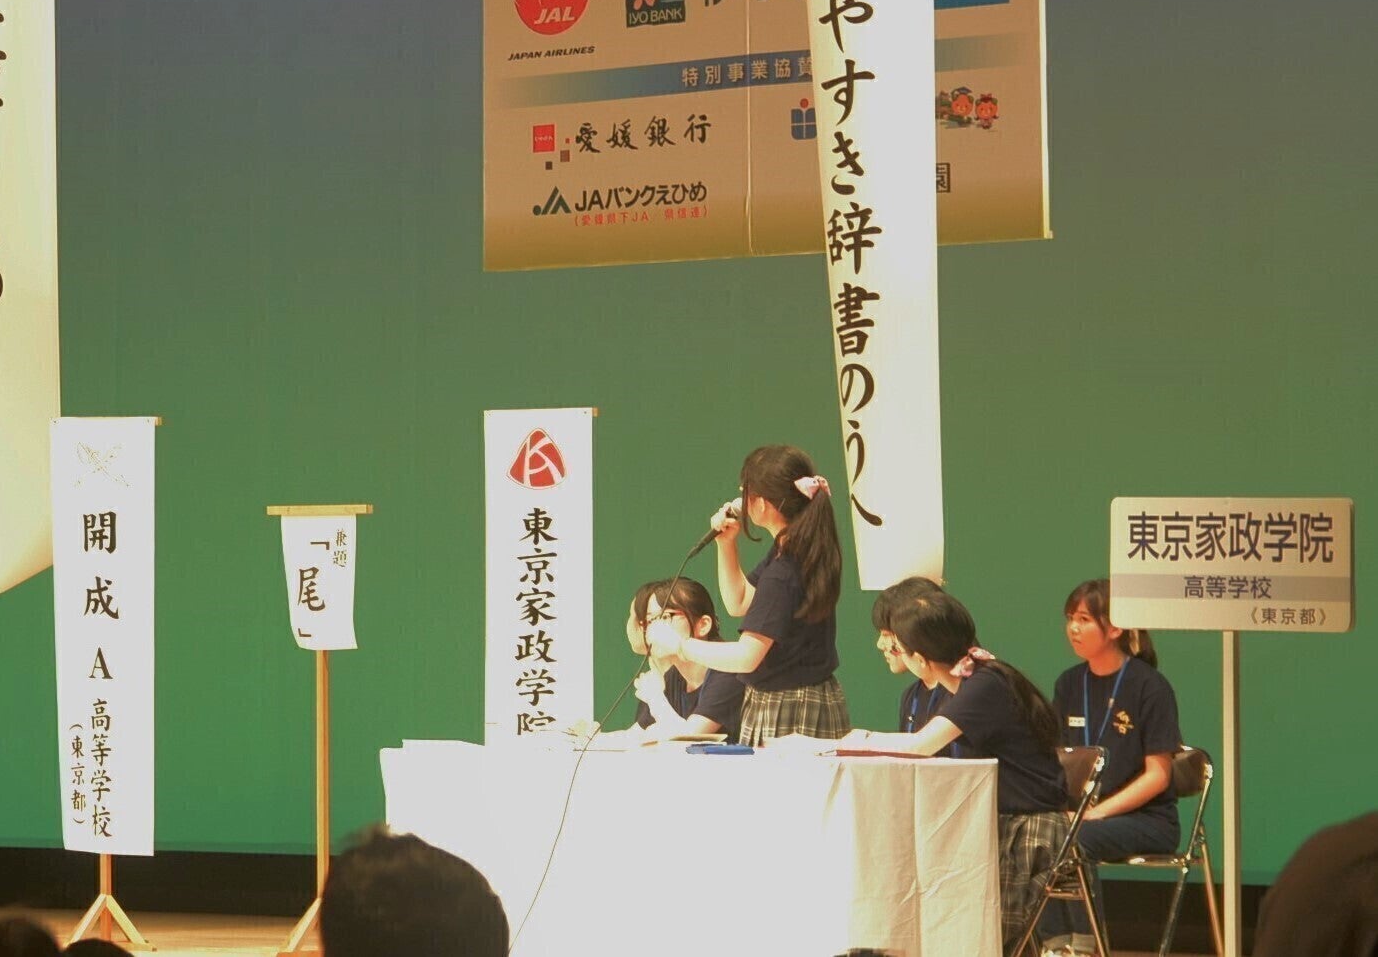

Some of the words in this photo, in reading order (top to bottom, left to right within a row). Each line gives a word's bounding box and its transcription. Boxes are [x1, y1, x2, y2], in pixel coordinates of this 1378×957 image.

[534, 7, 575, 25] JAL
[629, 12, 648, 25] IYO
[650, 8, 683, 23] BANK
[508, 50, 542, 61] JAPAN
[544, 46, 595, 58] AIRLINES
[575, 114, 712, 153] 愛媛銀行
[575, 181, 708, 212] JAバンクえひめ
[1127, 511, 1334, 563] 東京家政学院
[1184, 575, 1273, 599] 高等学校
